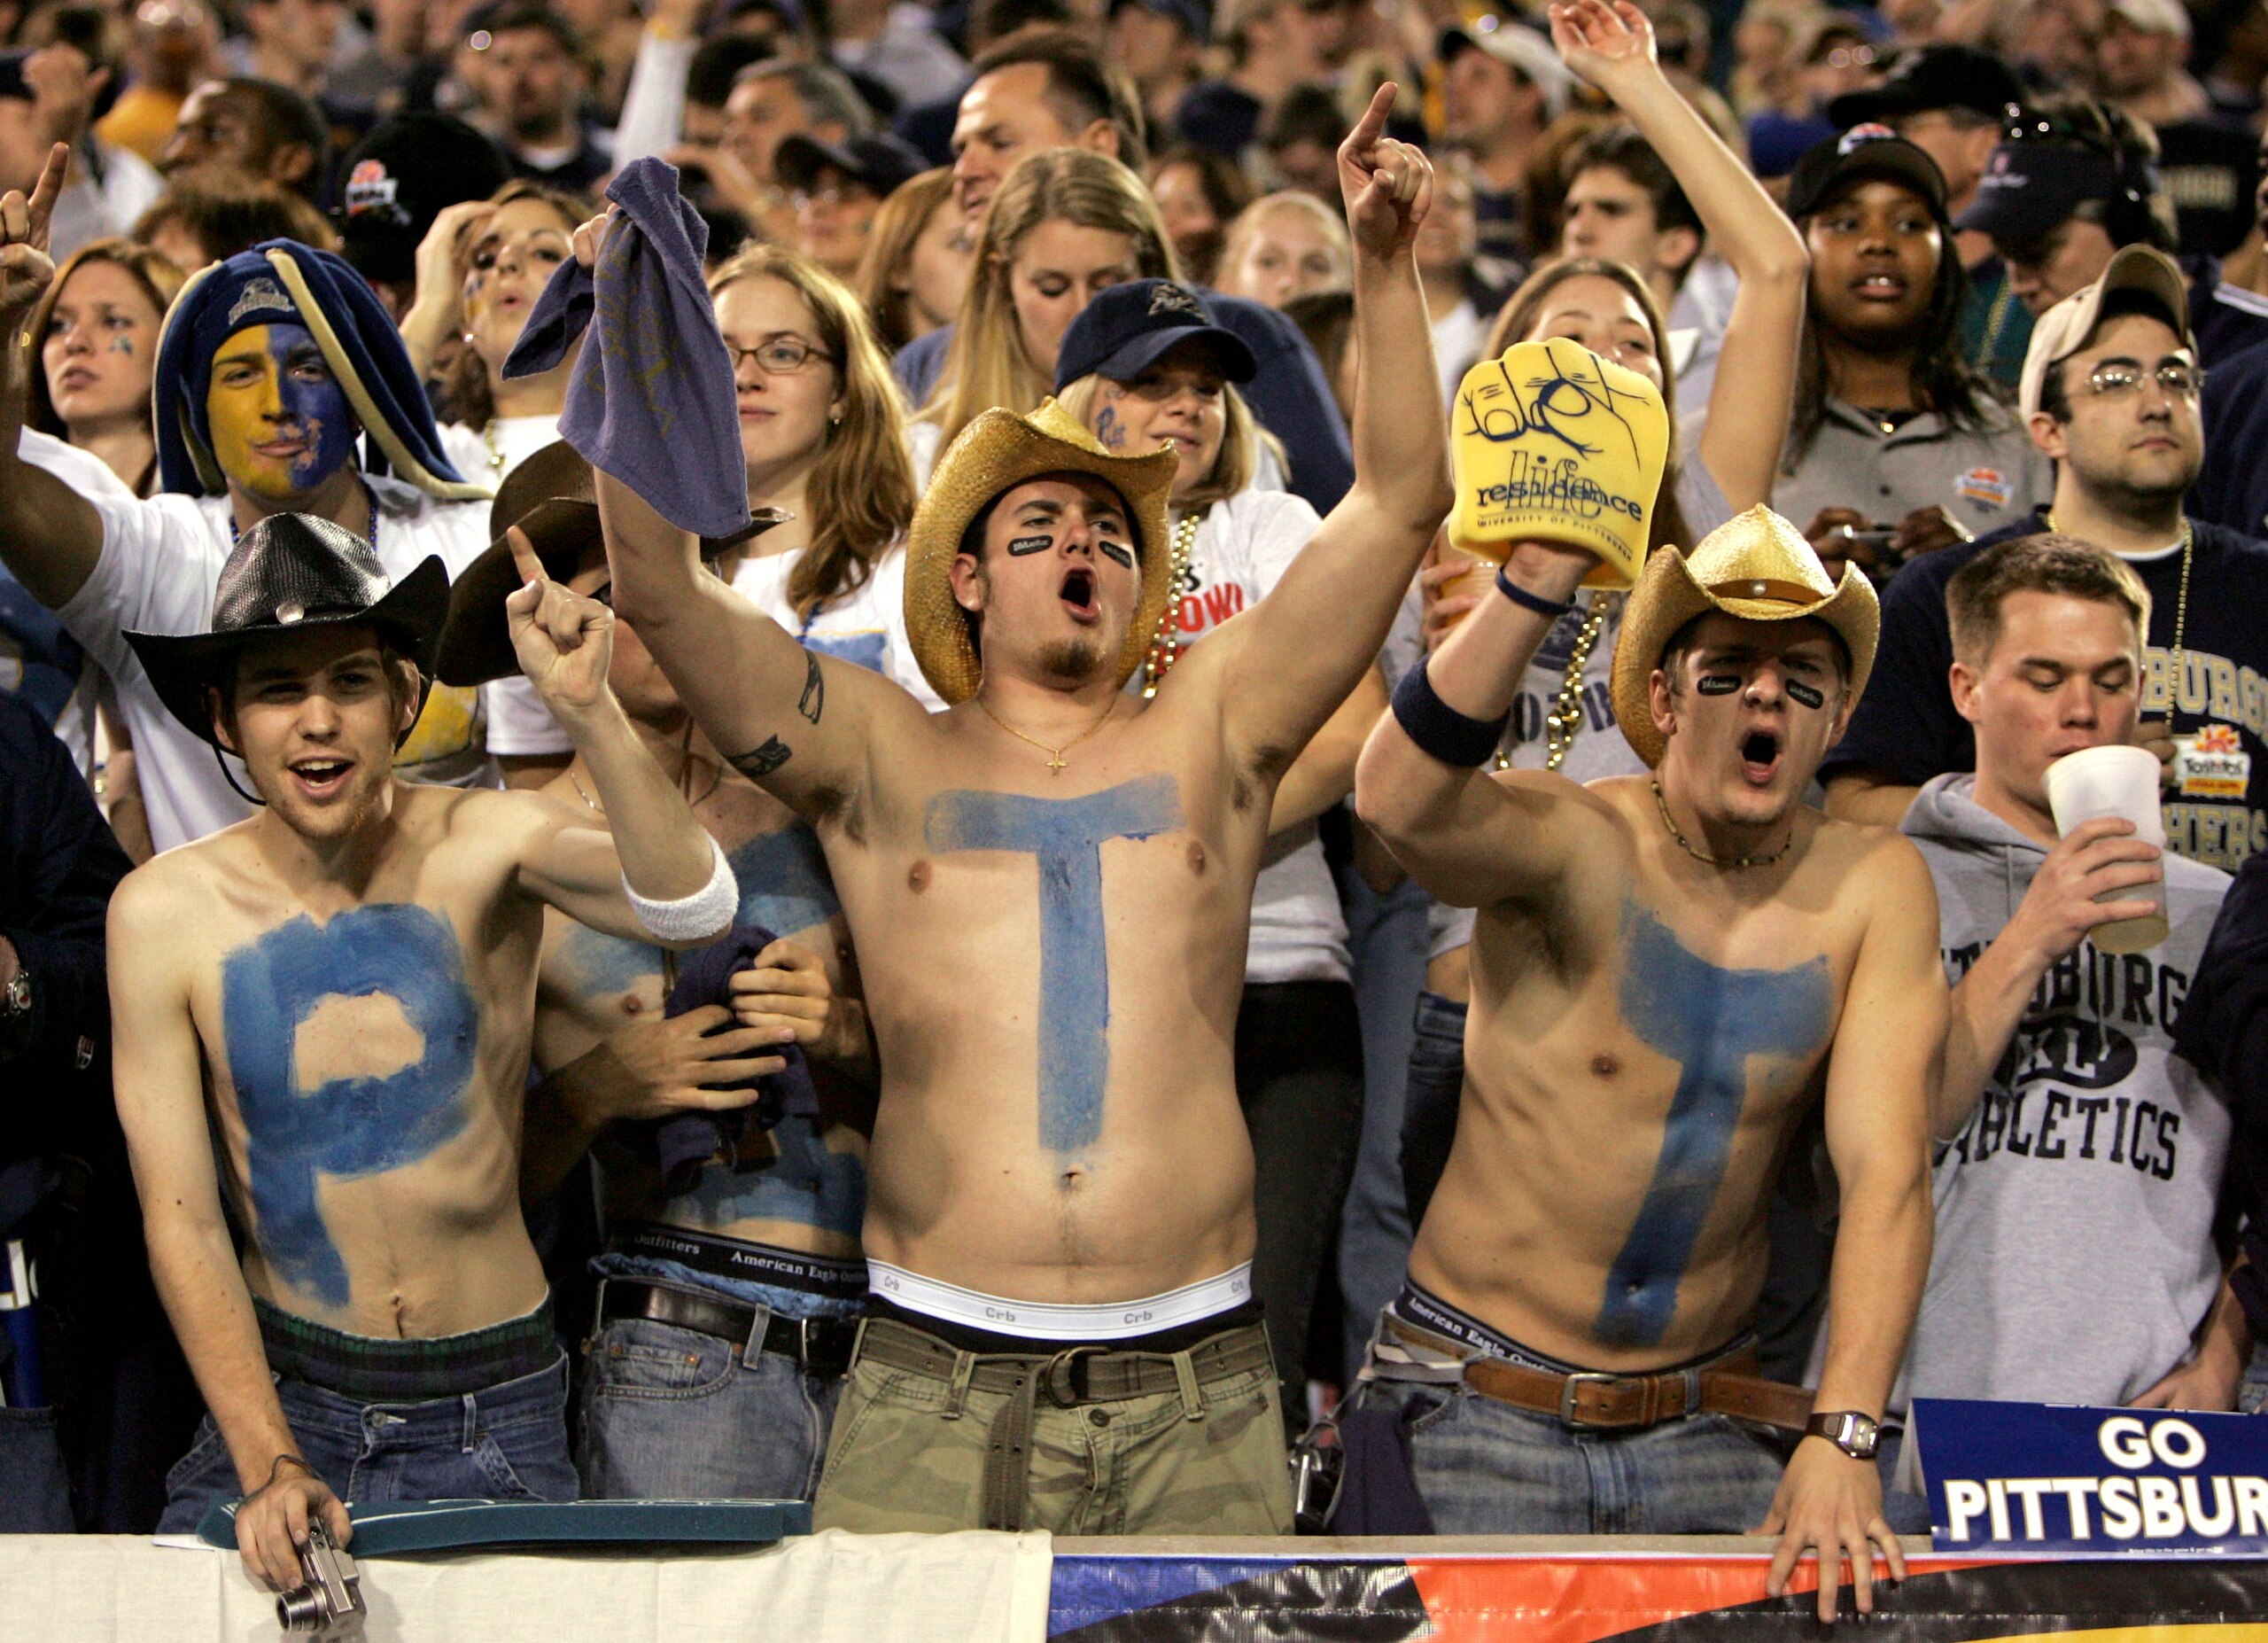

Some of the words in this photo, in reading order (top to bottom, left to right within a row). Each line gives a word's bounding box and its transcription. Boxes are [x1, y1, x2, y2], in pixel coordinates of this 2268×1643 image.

[1506, 450, 1602, 519] life
[2141, 646, 2268, 746] BURG
[923, 772, 1187, 1152] T
[221, 902, 479, 1307] P
[634, 1233, 700, 1255] Outfitters
[731, 1250, 804, 1275] American
[985, 1307, 1015, 1323] Crb
[1123, 1311, 1152, 1324] Crb
[1409, 1296, 1463, 1335] American
[1466, 1329, 1504, 1358] Eagle
[2098, 1415, 2207, 1469] GO
[1943, 1476, 2268, 1542] PITTSBUR
